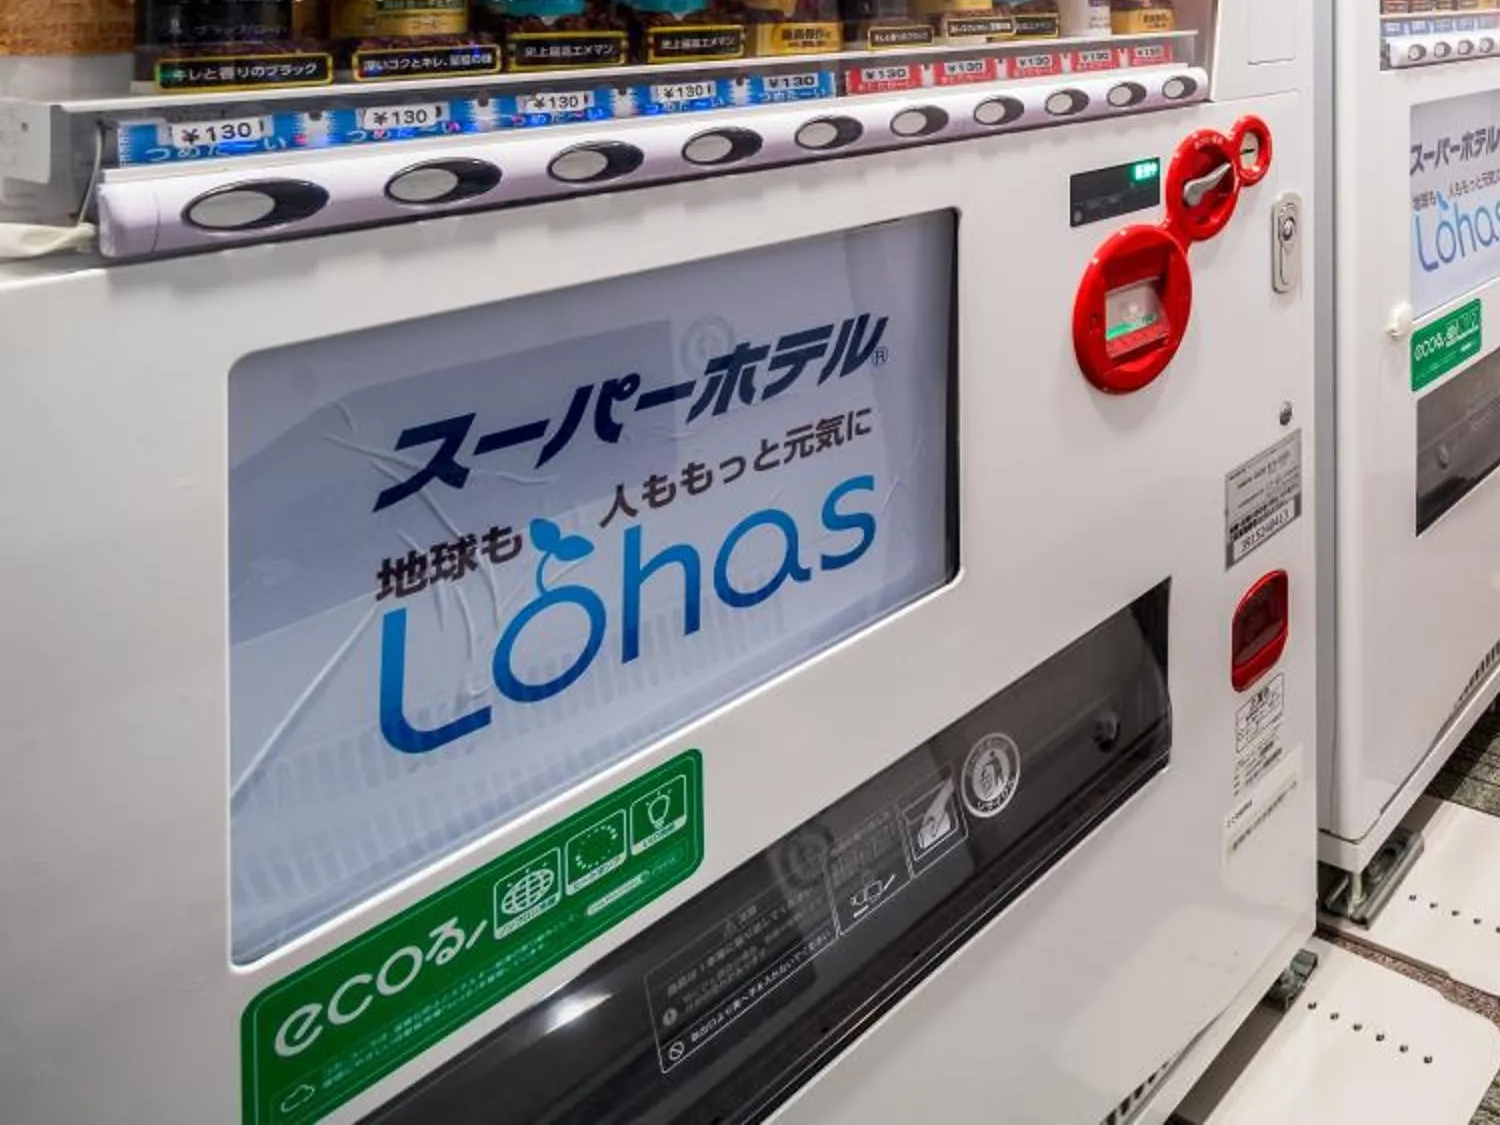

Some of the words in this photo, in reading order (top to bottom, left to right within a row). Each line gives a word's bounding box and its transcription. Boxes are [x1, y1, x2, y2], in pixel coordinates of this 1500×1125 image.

[663, 83, 704, 98] ¥130
[769, 74, 815, 88] ¥130
[373, 109, 428, 127] ¥130
[533, 95, 579, 111] ¥130
[182, 124, 251, 146] ¥130
[1410, 125, 1500, 176] スーパーホテル
[372, 312, 888, 513] スーパーホテル
[600, 407, 873, 528] 人ももっと元気に
[375, 525, 523, 602] 地球も
[379, 475, 877, 755] Lohas
